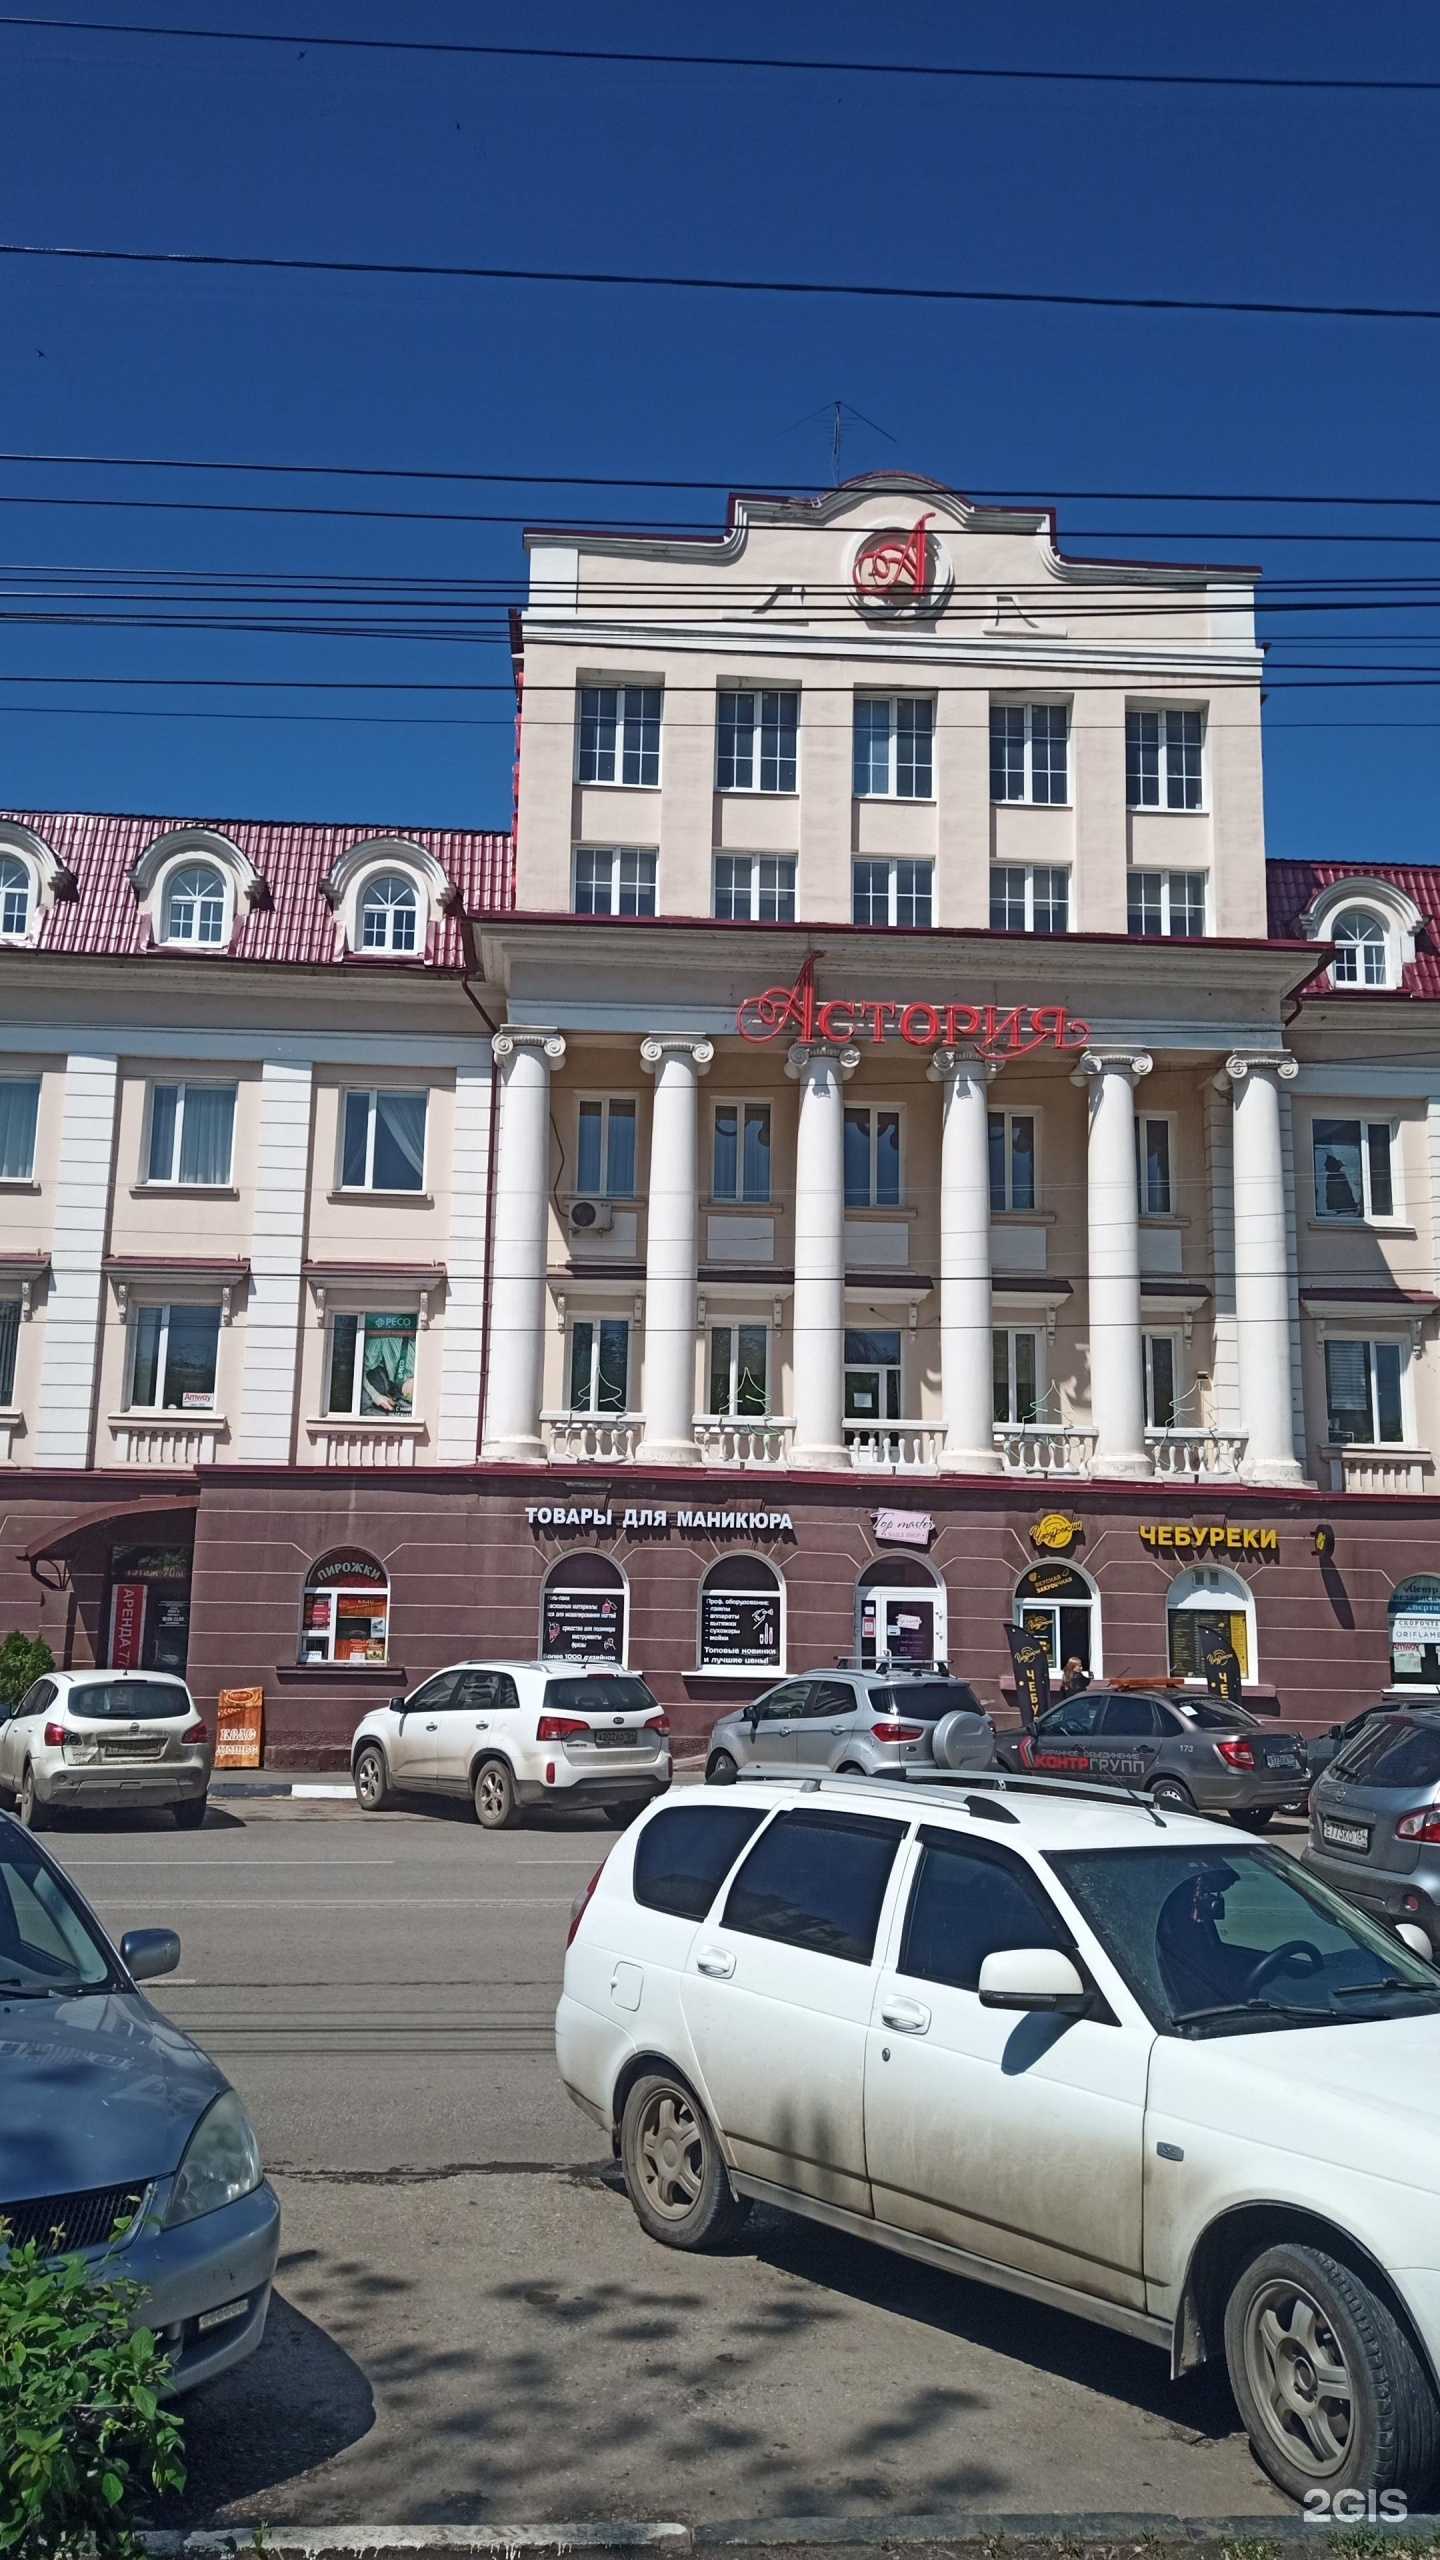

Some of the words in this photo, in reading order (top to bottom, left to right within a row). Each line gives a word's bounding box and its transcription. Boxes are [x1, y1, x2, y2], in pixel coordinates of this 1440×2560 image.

[184, 1392, 212, 1402] Amway
[525, 1507, 612, 1525] ТОВАРЫ
[622, 1510, 667, 1528] ДЛЯ
[677, 1511, 793, 1530] МАНИКЮРА
[1139, 1525, 1278, 1549] ЧЕБУРЕКИ
[317, 1562, 381, 1580] ПИРОЖКИ
[119, 1588, 136, 1648] АРЕНДА
